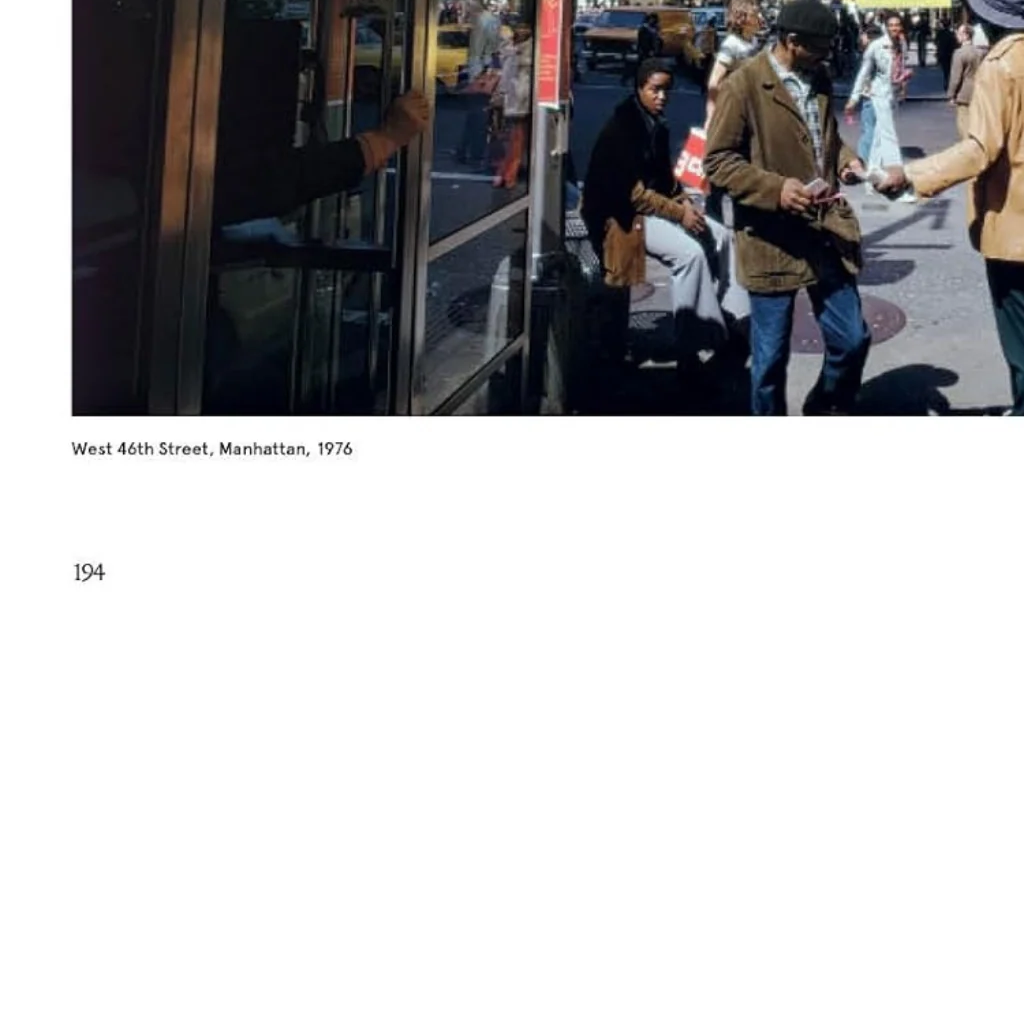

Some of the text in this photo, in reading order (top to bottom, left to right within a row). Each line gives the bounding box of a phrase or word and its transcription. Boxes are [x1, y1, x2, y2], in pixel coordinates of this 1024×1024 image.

[71, 441, 353, 457] West 46th Street, Manhattan, 1976
[74, 563, 106, 583] 194
